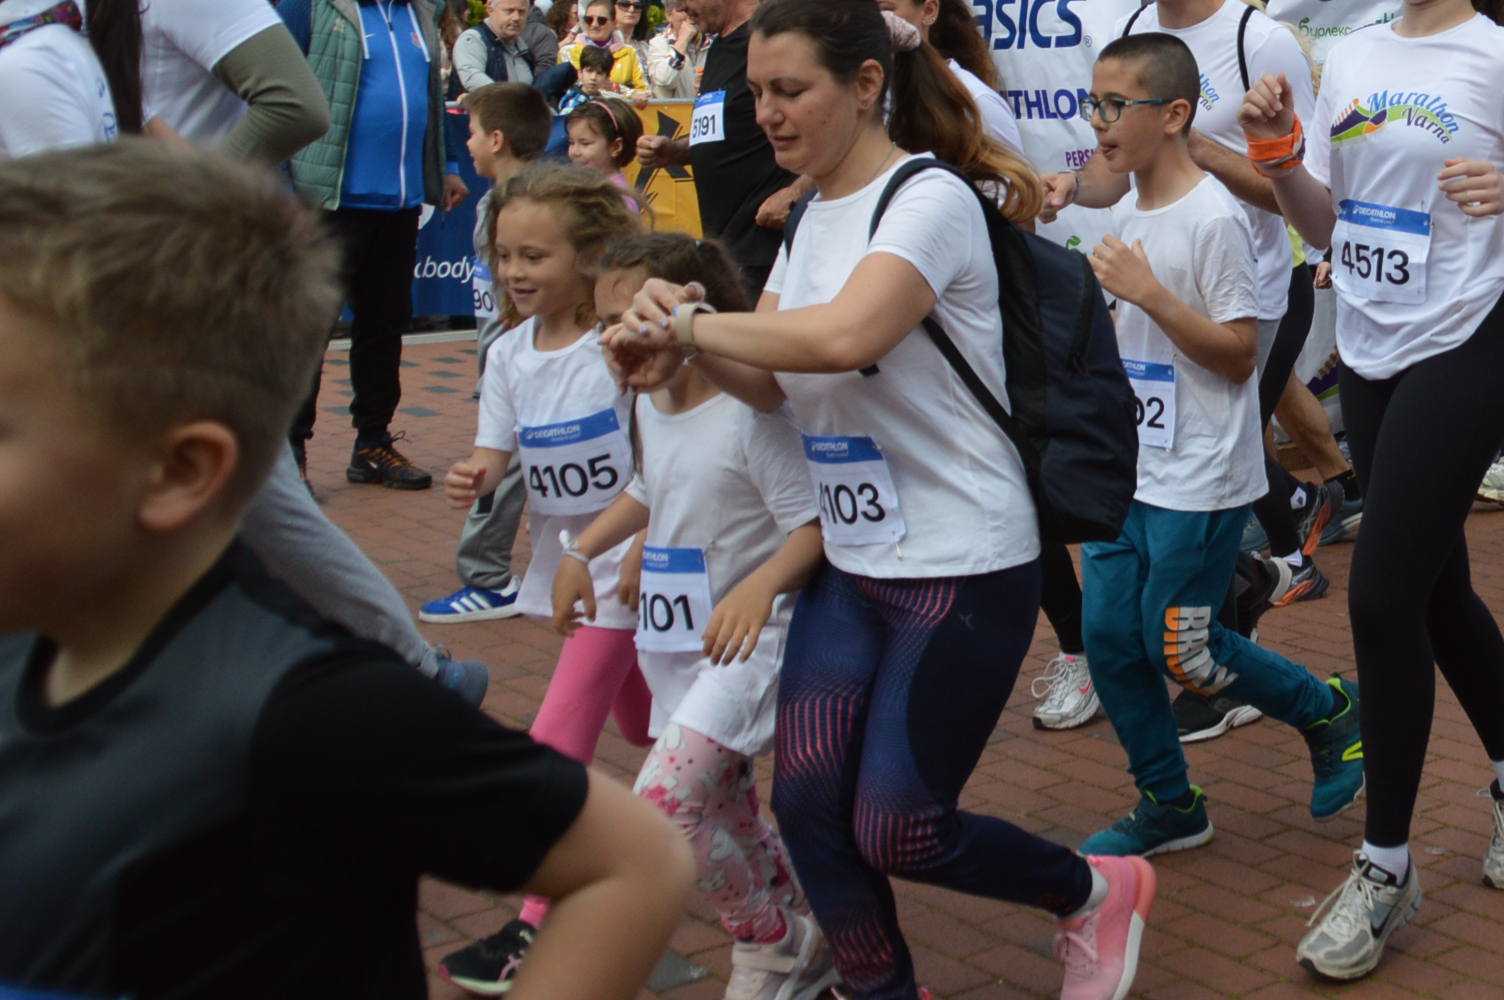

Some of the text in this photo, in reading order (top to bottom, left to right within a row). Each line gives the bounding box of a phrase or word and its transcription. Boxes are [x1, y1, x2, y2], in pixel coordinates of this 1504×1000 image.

[1367, 89, 1460, 135] Marathon
[1401, 106, 1451, 145] Varna
[1341, 240, 1410, 286] 4513
[530, 453, 619, 498] 4105
[639, 592, 694, 633] 101
